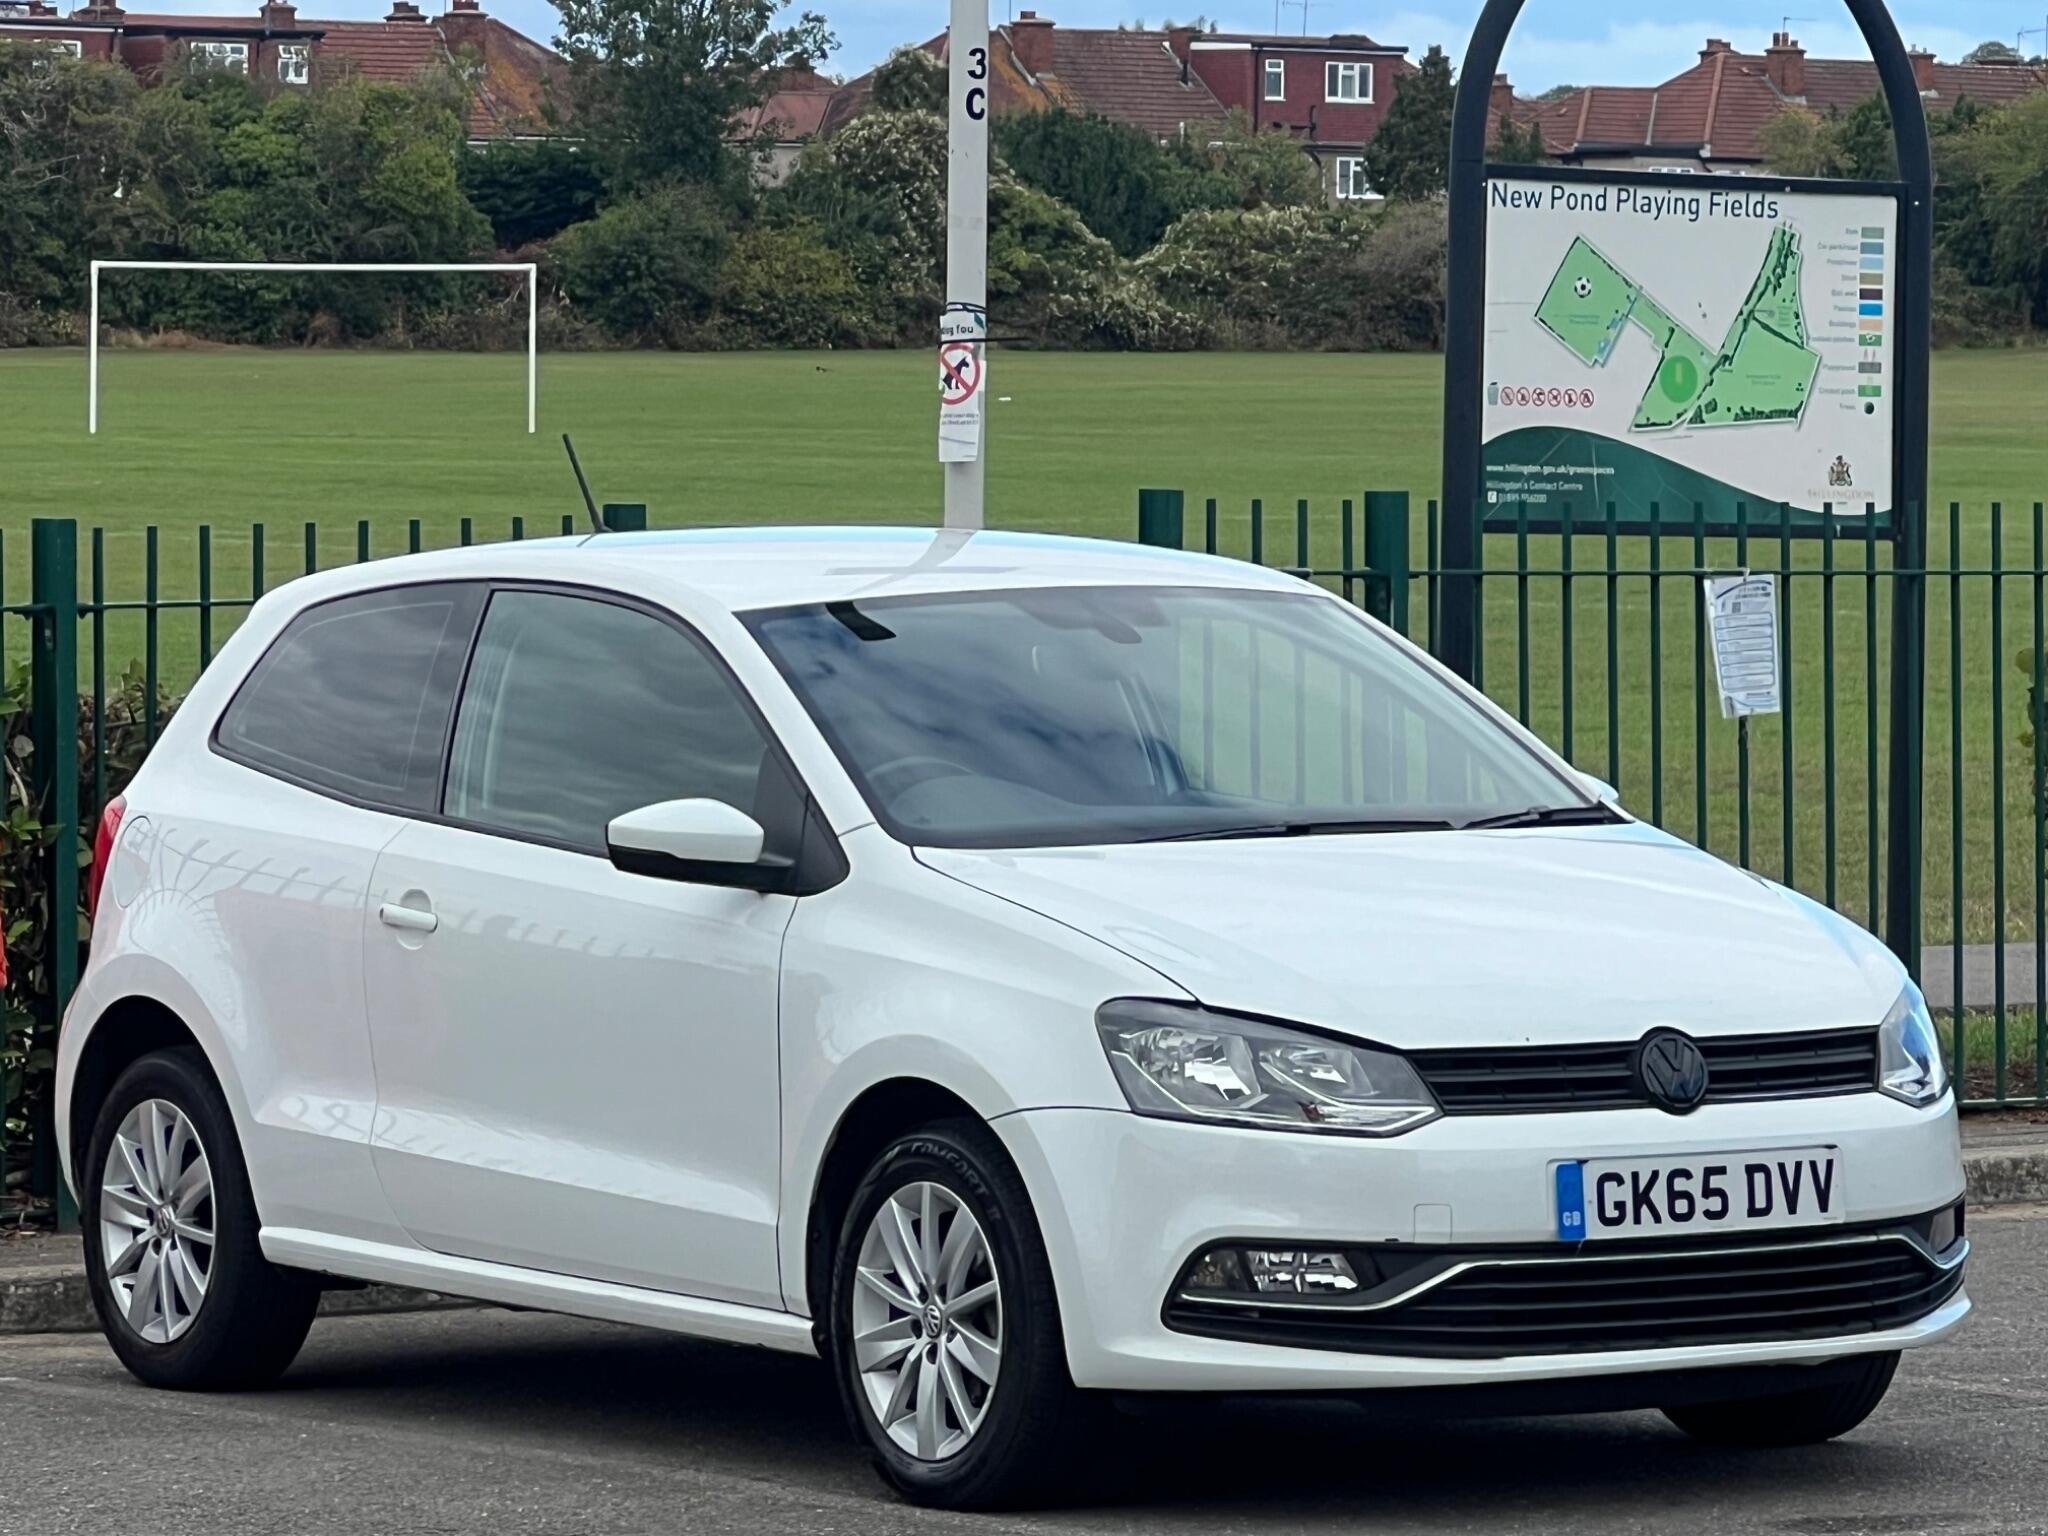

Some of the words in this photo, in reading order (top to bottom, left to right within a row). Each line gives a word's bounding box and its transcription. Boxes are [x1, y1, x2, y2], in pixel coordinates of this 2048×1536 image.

[967, 47, 987, 80] 3
[965, 87, 985, 121] C
[1491, 182, 1543, 209] New
[1550, 185, 1608, 212] Pond
[1616, 187, 1700, 222] Playing
[1709, 191, 1779, 219] Fields
[1596, 1165, 1729, 1227] GK65
[1744, 1158, 1834, 1218] DVV
[1563, 1211, 1581, 1226] GB
